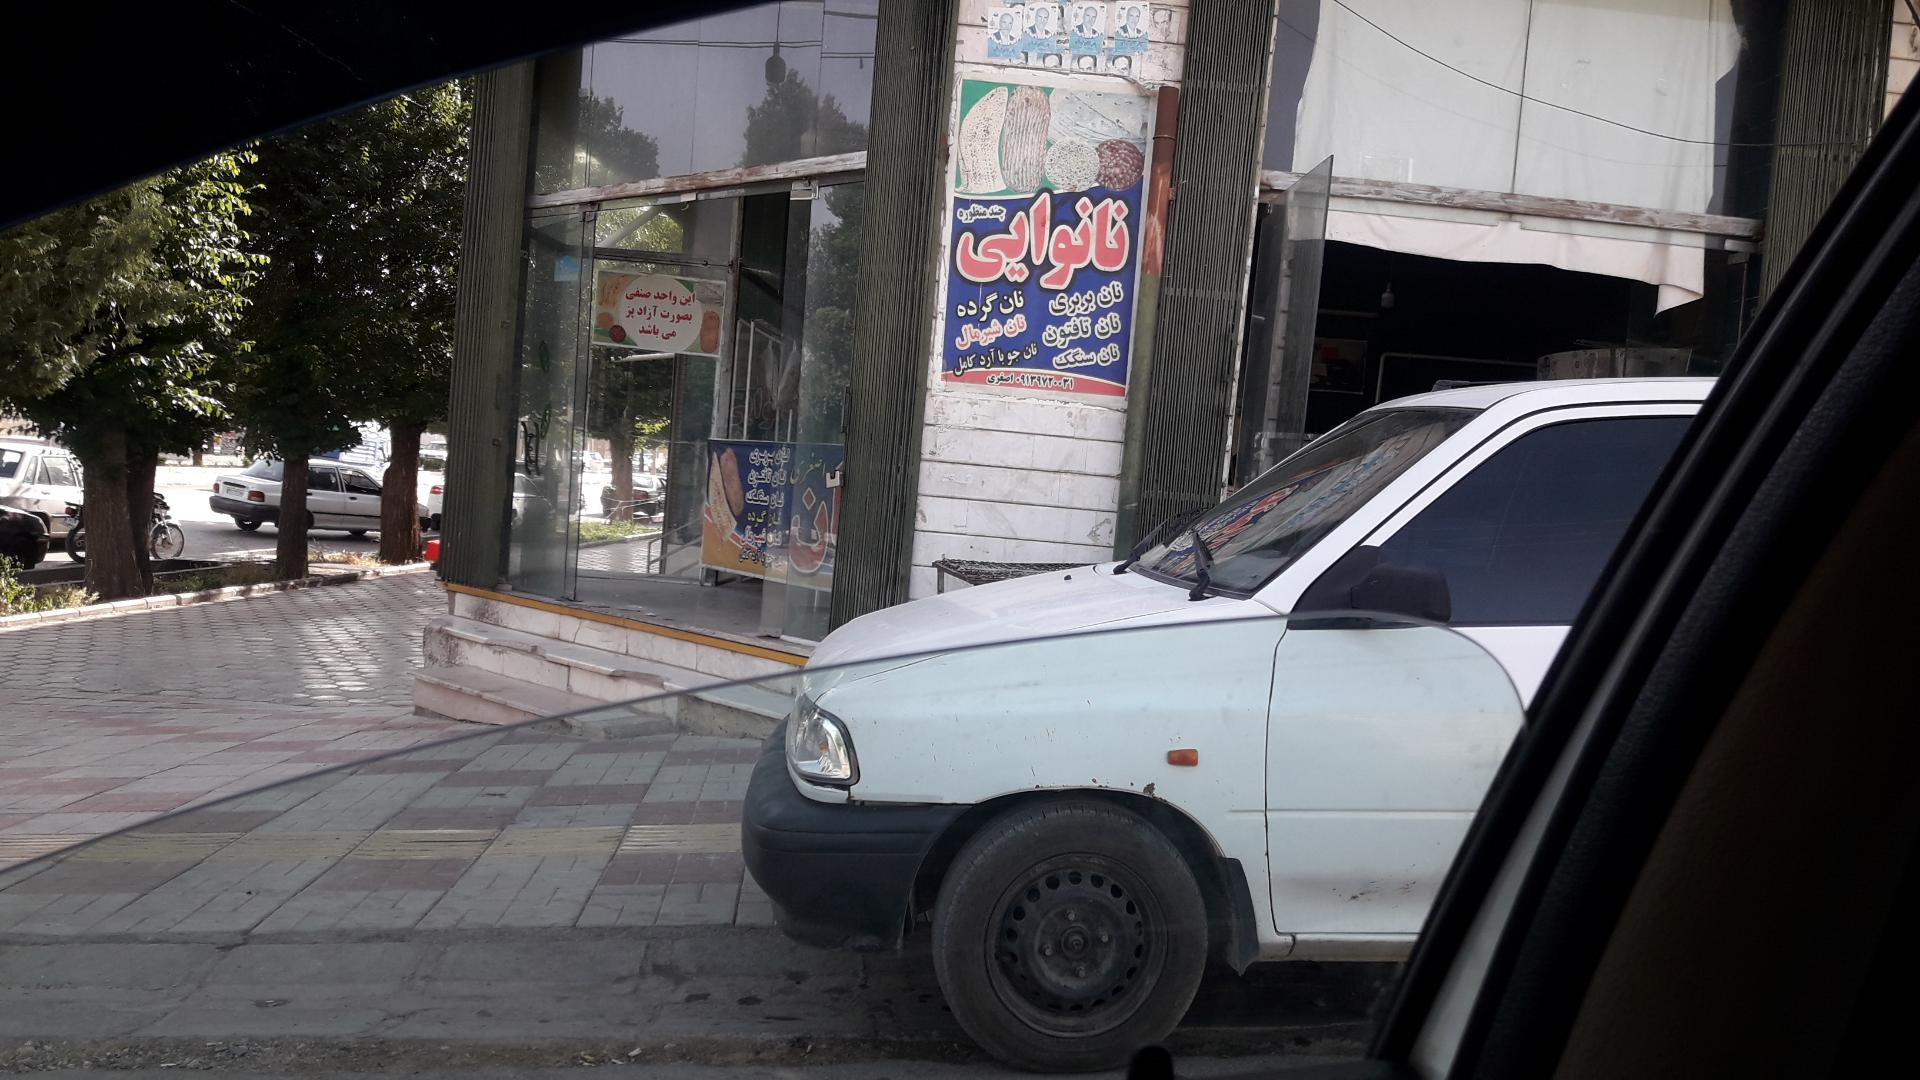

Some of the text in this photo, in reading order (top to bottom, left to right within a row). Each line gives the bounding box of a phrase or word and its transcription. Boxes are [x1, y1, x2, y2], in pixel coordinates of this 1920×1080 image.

[957, 204, 1006, 223] چند منظوره
[956, 192, 1129, 289] نانوایی
[626, 288, 696, 305] این واحد صنفی
[957, 290, 1024, 322] نان گرده
[1049, 281, 1123, 316] نان بربری
[626, 306, 692, 324] بصورت آزاد پز
[638, 324, 676, 340] می باشد
[956, 314, 1027, 350] نان شیرمال
[1042, 312, 1121, 348] نان تافتون
[954, 343, 1038, 375] نان جو با آرد کامل
[1053, 343, 1120, 369] نان سنگک
[987, 372, 1014, 386] اصغری
